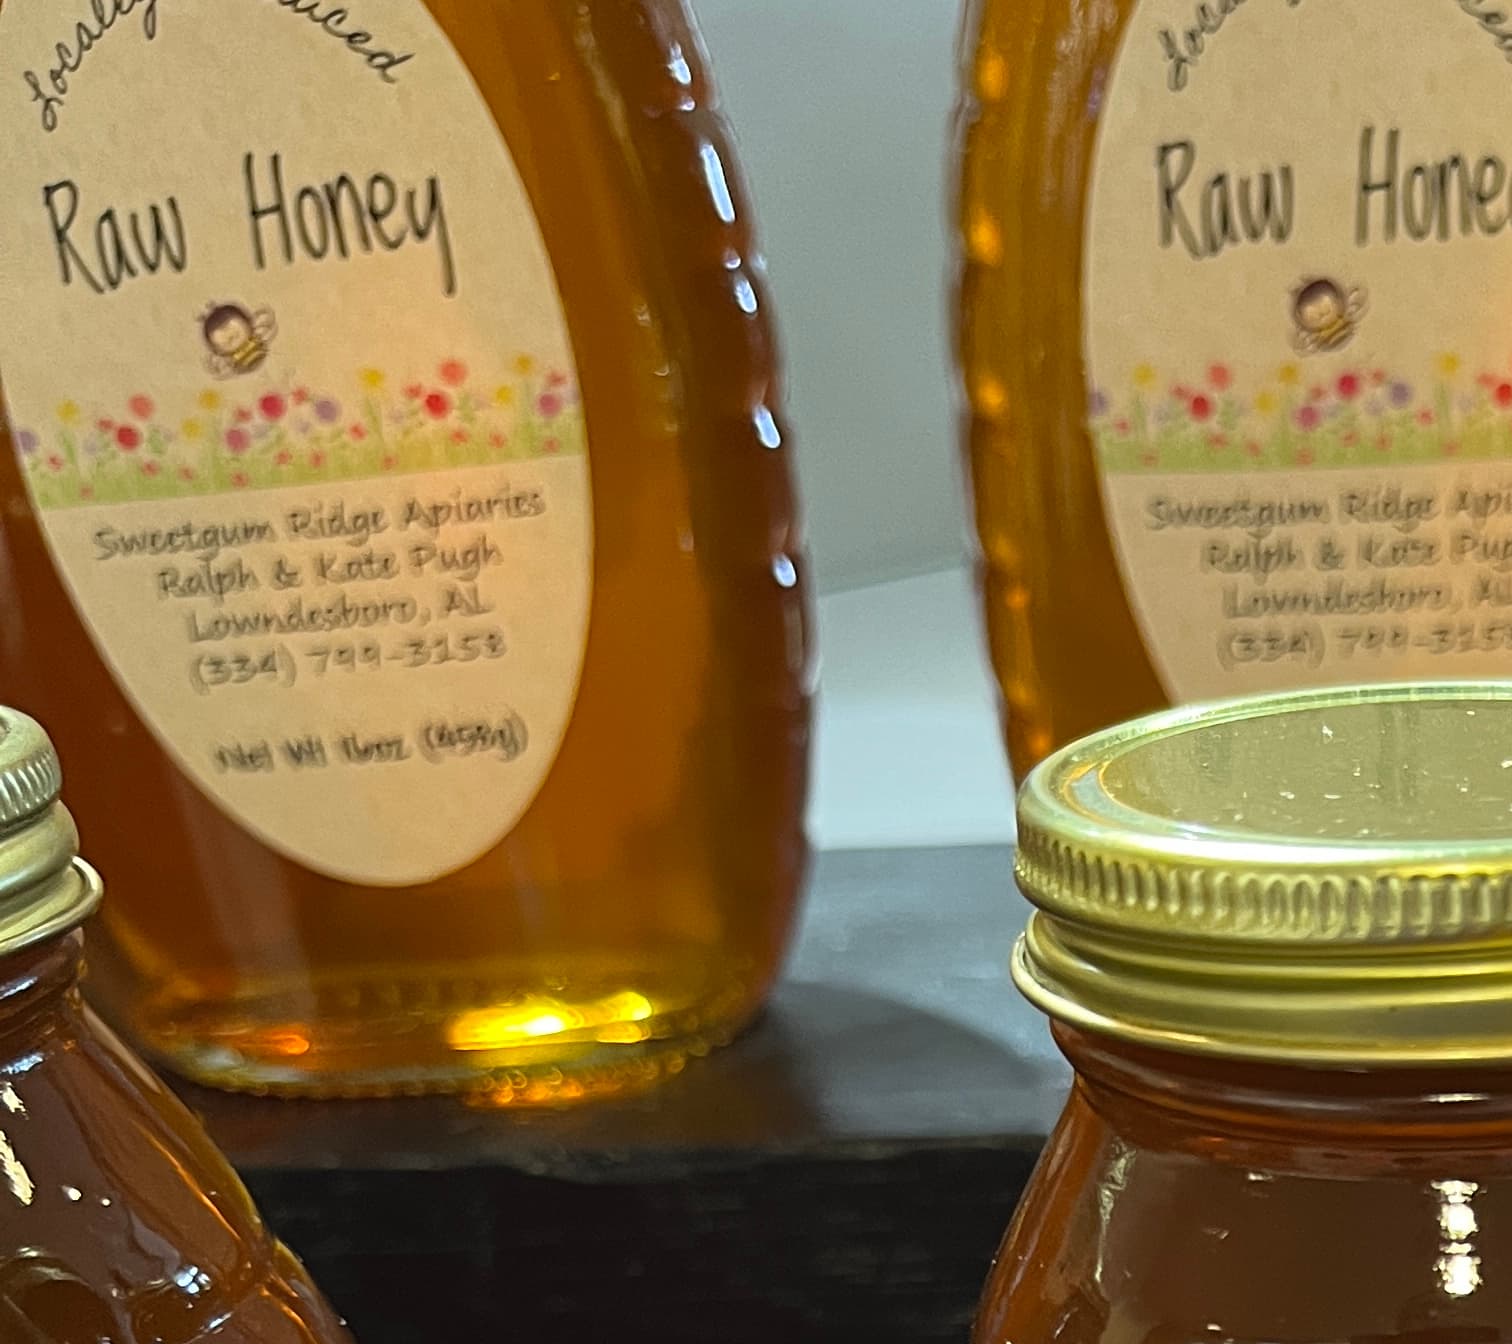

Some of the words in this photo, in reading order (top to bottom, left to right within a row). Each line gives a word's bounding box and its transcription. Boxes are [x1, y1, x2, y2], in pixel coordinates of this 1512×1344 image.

[43, 178, 188, 294] Raw
[242, 151, 458, 298] Honey
[1156, 139, 1296, 261] Raw
[93, 516, 277, 562] Sweetgum
[288, 503, 390, 546] Ridge
[402, 485, 547, 530] Apiaries
[157, 562, 260, 603] Ralph
[274, 558, 303, 589] &
[316, 548, 400, 585] Kate
[408, 534, 505, 582] Pugh
[441, 583, 497, 617] AL
[188, 640, 299, 695] (334)
[304, 629, 508, 677] 799-3158
